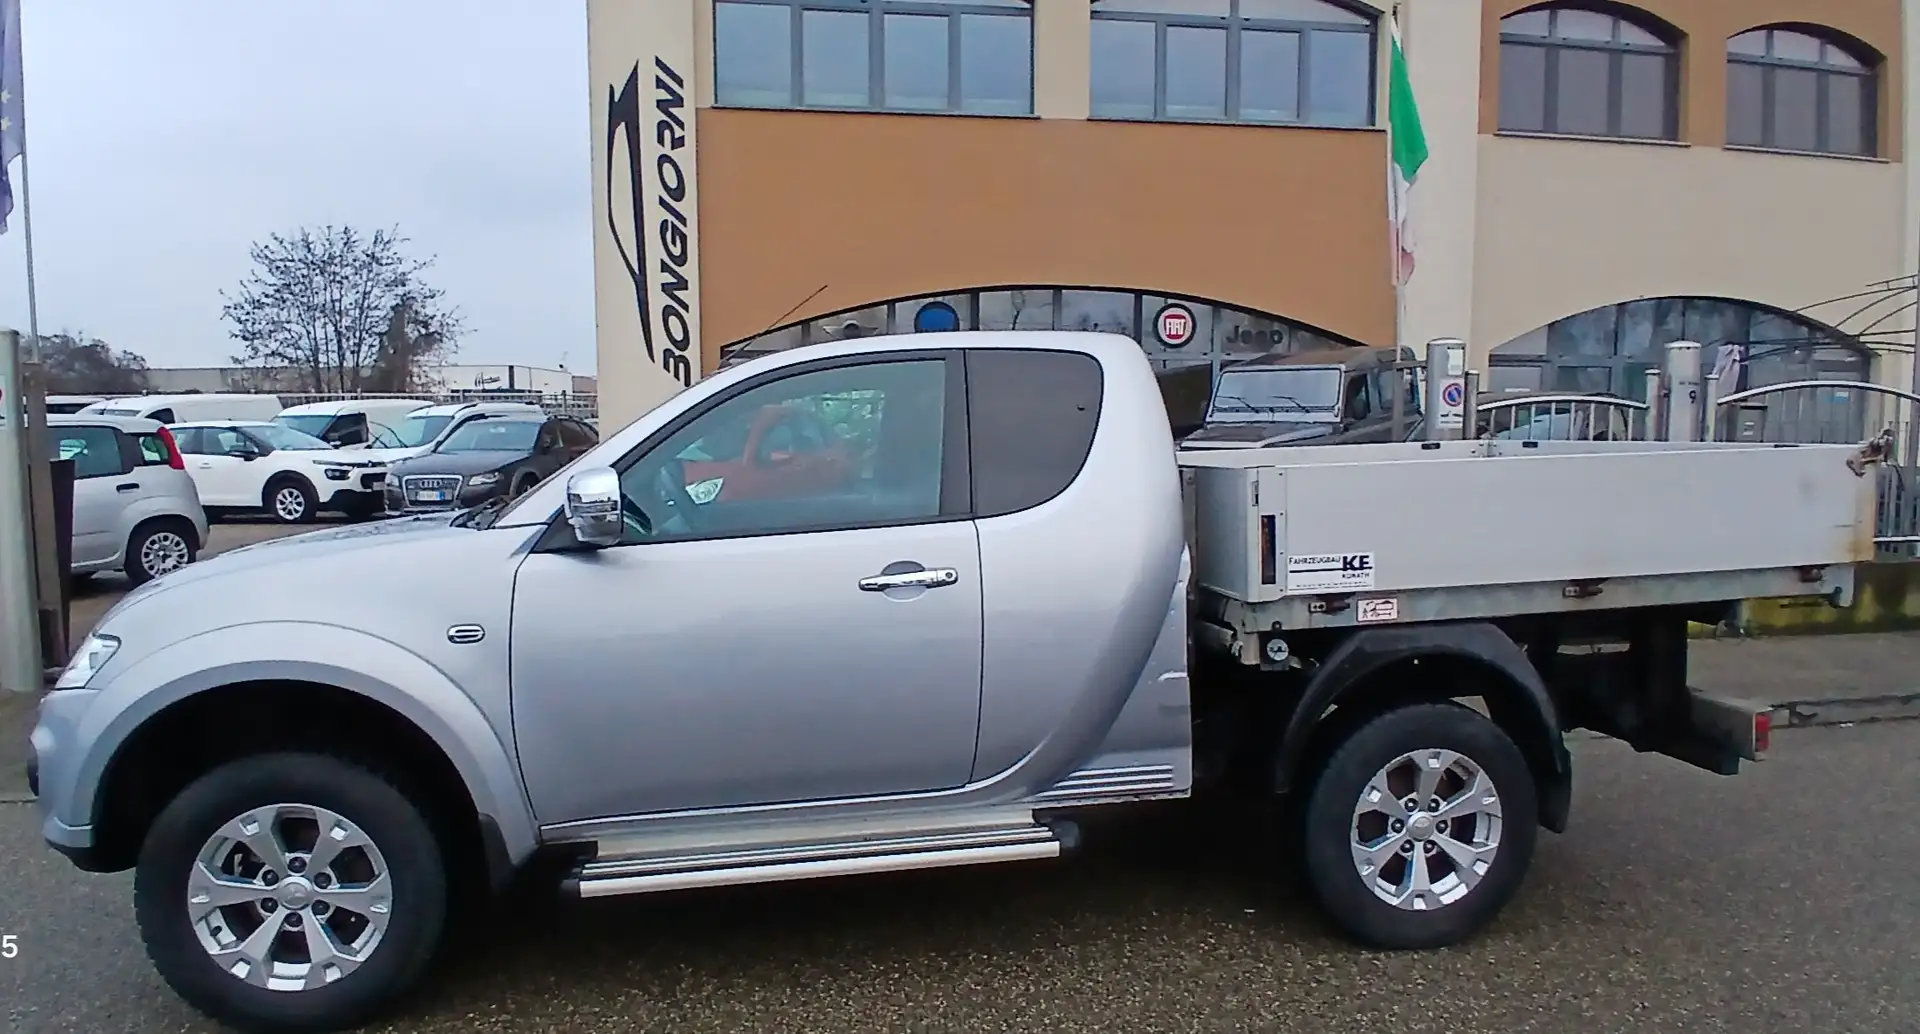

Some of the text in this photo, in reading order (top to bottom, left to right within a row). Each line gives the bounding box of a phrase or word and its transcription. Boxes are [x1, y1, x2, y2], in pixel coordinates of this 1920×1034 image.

[655, 55, 692, 388] BONGIORNI
[1165, 318, 1185, 335] FIAT
[1688, 390, 1697, 404] 9
[1342, 555, 1370, 571] KE
